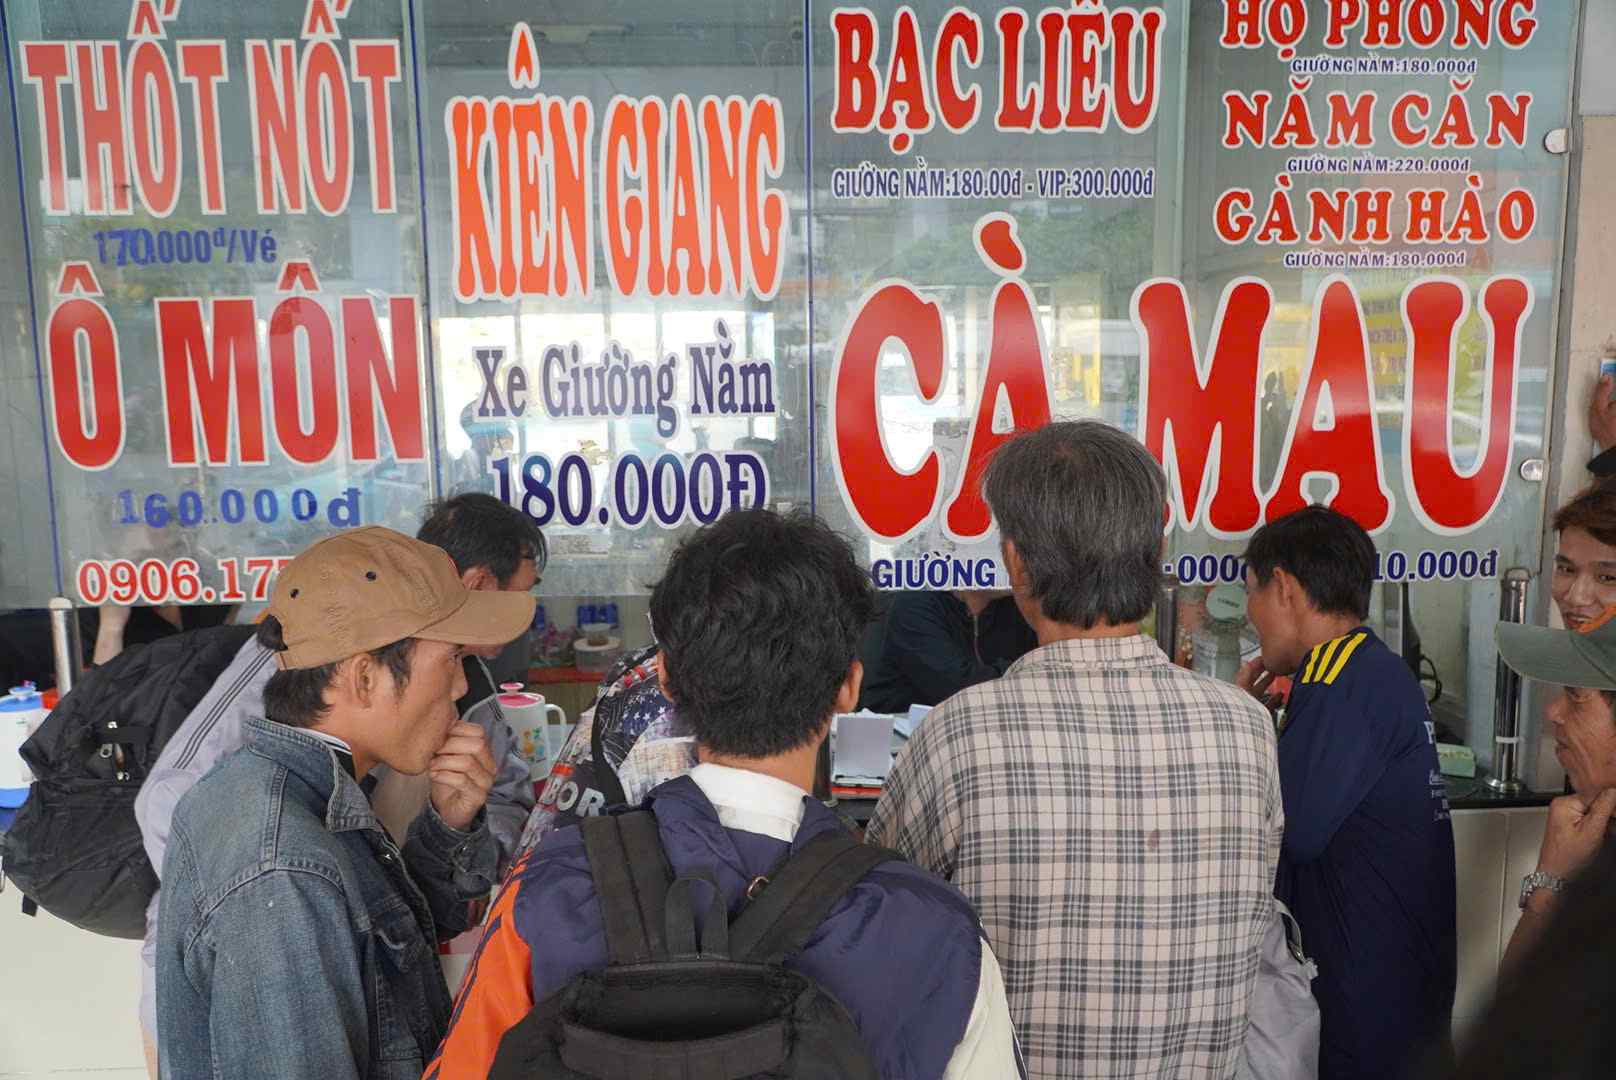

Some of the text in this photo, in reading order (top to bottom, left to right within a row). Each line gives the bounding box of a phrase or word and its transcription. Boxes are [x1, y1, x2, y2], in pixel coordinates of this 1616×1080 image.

[1220, 0, 1537, 60] HỌ PHONG
[1291, 54, 1354, 74] GIƯỜNG
[20, 0, 402, 218] THỐT NỐT
[831, 0, 1166, 154] BẠC LIÊU
[1222, 76, 1532, 148] NĂM CĂN
[444, 21, 789, 304] KIÊN GIANG
[832, 161, 900, 198] GIƯỜNG
[1037, 167, 1156, 198] VIP:300.000đ
[1287, 153, 1348, 173] GIƯỜNG
[1214, 174, 1536, 244] GÀNH HÀO
[1284, 249, 1345, 268] GIƯỜNG
[46, 257, 427, 471] Ô MÔN
[472, 317, 778, 441] Xe Giường Nằm
[829, 210, 1536, 545] CÀ MAU
[871, 551, 997, 589] GIƯỜNG
